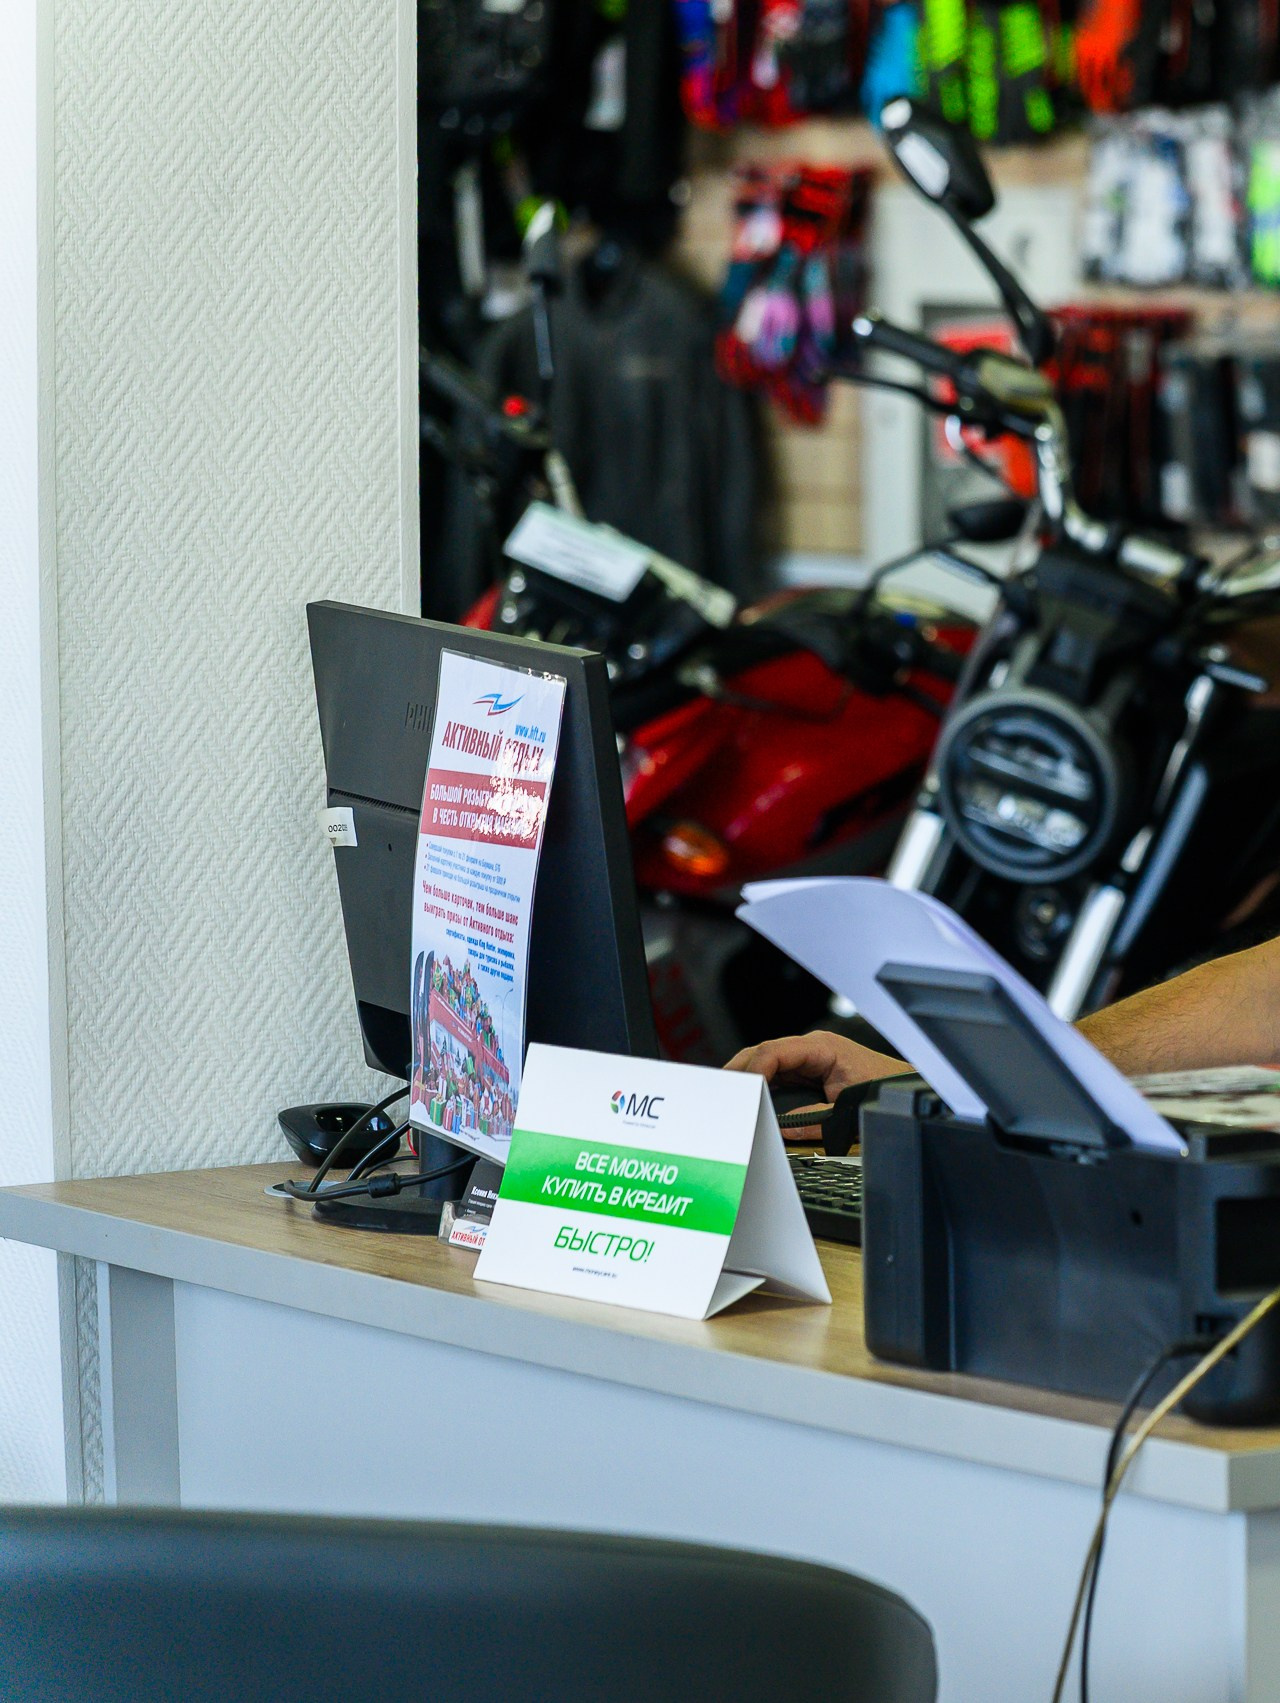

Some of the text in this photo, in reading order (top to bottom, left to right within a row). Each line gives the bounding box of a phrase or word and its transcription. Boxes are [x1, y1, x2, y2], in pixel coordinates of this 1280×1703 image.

[442, 720, 503, 762] АКТИВНЫЙ
[430, 784, 462, 804] БОЛЬШОЙ
[432, 808, 438, 824] В
[439, 808, 458, 826] ЧЕСТЬ
[423, 880, 518, 926] Чем больше карточек, тем больше шанс
[424, 902, 514, 944] выиграть призы от Активного отдыха:
[575, 1151, 678, 1185] ВСЕ МОЖНО
[541, 1175, 693, 1217] КУПИТЬ В КРЕДИТ
[452, 1231, 478, 1244] АКТИВНЫЙ
[554, 1226, 655, 1262] БЫСТРО!
